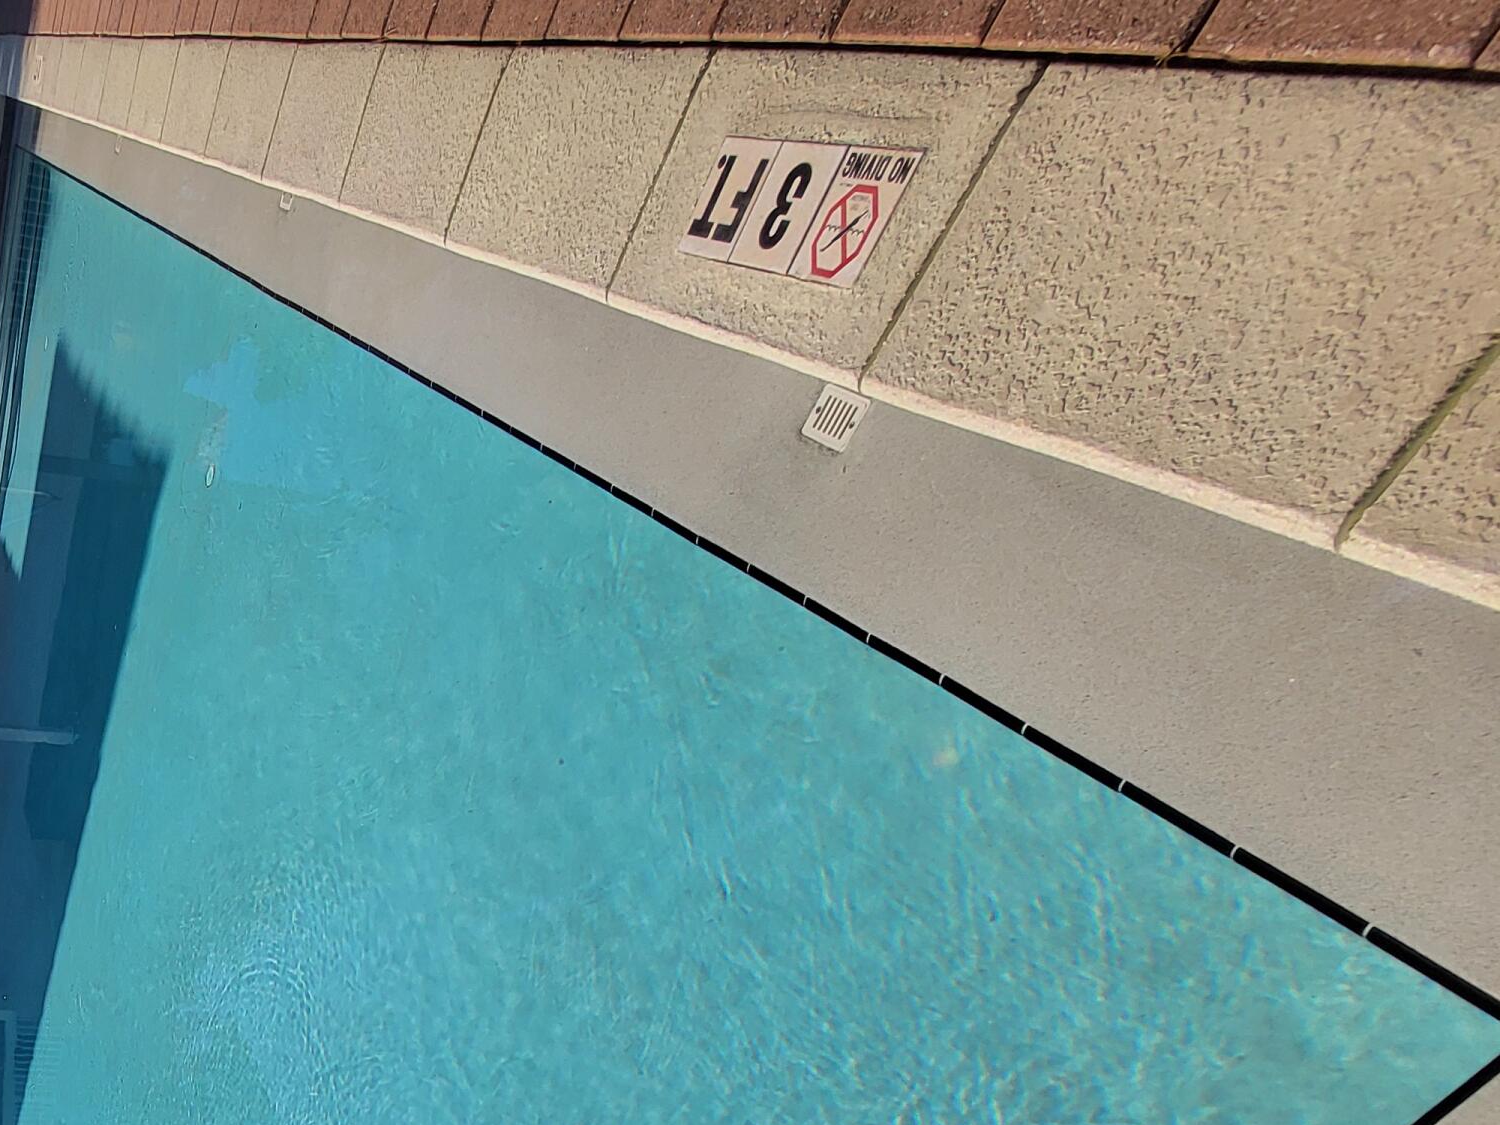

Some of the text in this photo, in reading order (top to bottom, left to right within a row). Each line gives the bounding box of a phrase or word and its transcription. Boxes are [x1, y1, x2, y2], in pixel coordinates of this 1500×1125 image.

[842, 153, 916, 184] NO DIVING
[758, 162, 812, 250] 3
